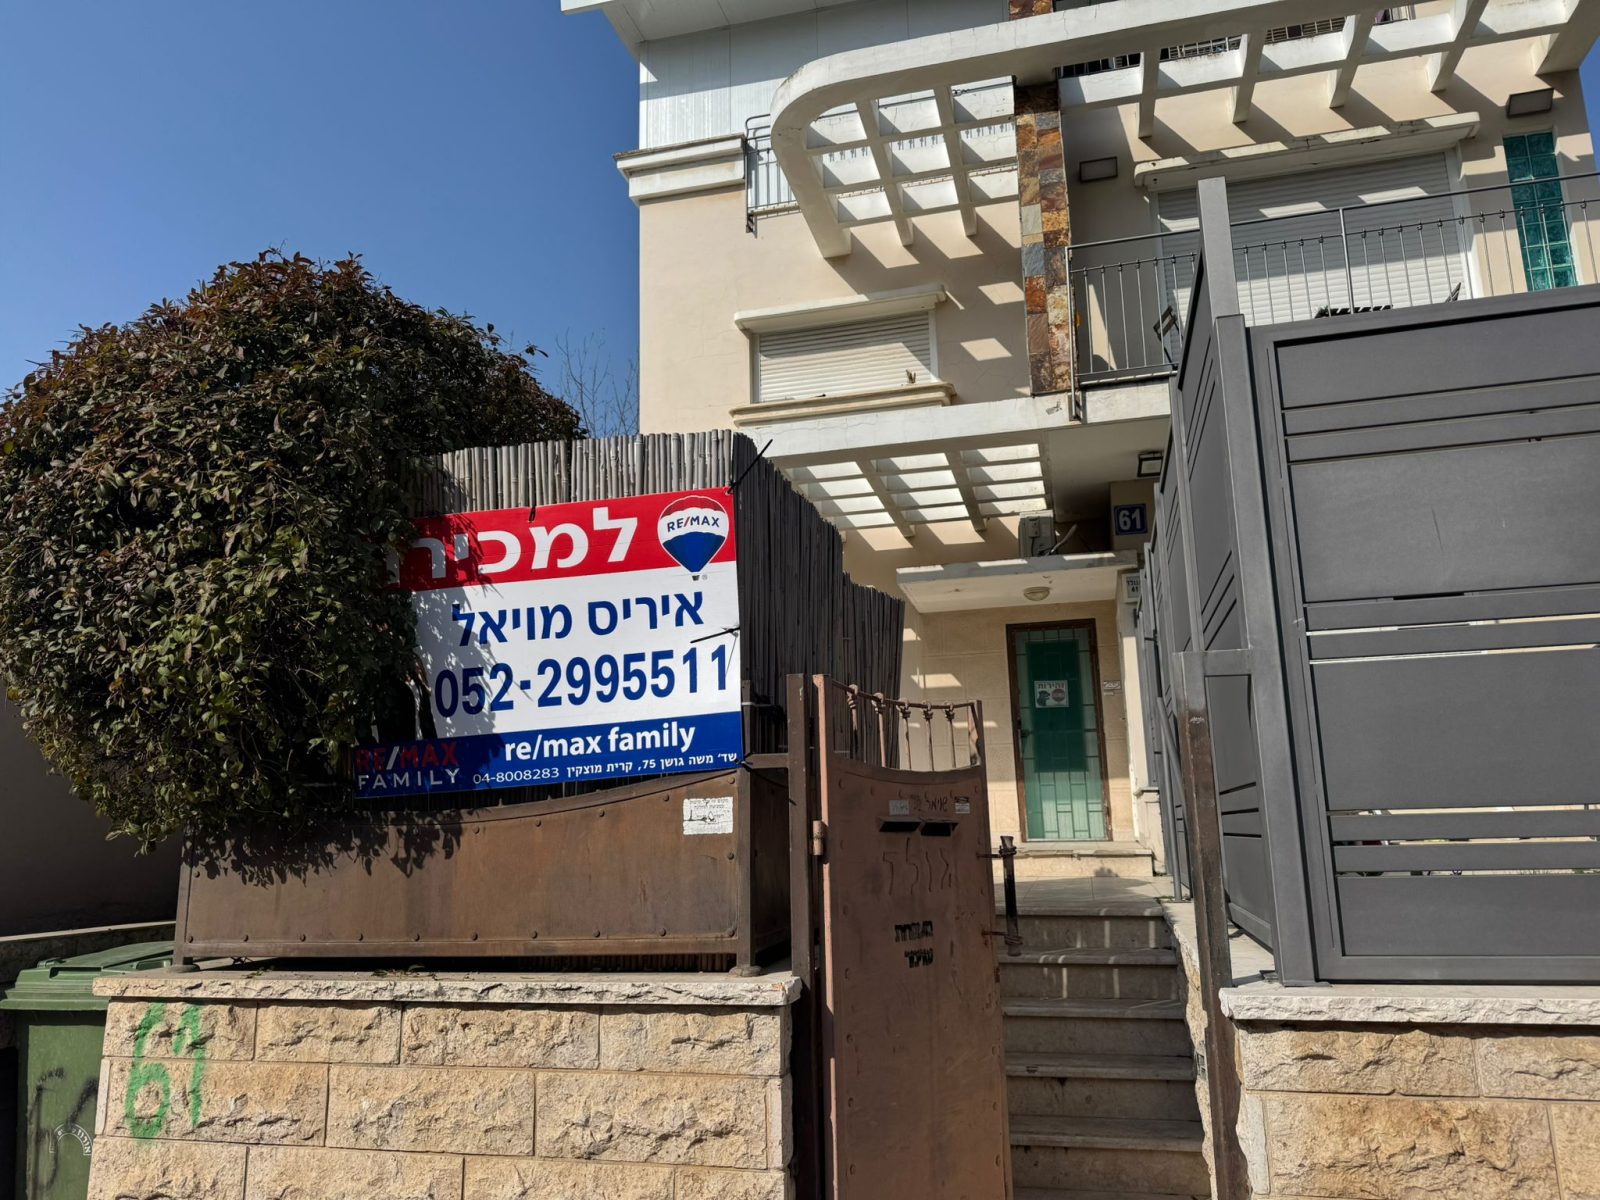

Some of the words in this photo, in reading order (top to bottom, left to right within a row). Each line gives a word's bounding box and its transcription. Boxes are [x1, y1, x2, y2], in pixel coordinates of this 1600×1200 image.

[667, 516, 720, 533] RE/MAX
[1118, 508, 1142, 531] 61
[386, 506, 638, 583] למכיר
[452, 602, 572, 647] מויאל
[588, 591, 704, 636] איריס
[434, 644, 727, 718] 052-2995511
[505, 734, 602, 762] re/max
[608, 721, 696, 752] family
[355, 741, 459, 771] RE/MAX
[606, 762, 633, 773] קרית
[660, 756, 684, 770] גושן
[688, 754, 713, 766] משה
[358, 768, 460, 790] FAMILY
[473, 767, 560, 784] 04-8008283
[566, 764, 602, 777] מוצקין
[124, 1002, 206, 1141] 61
